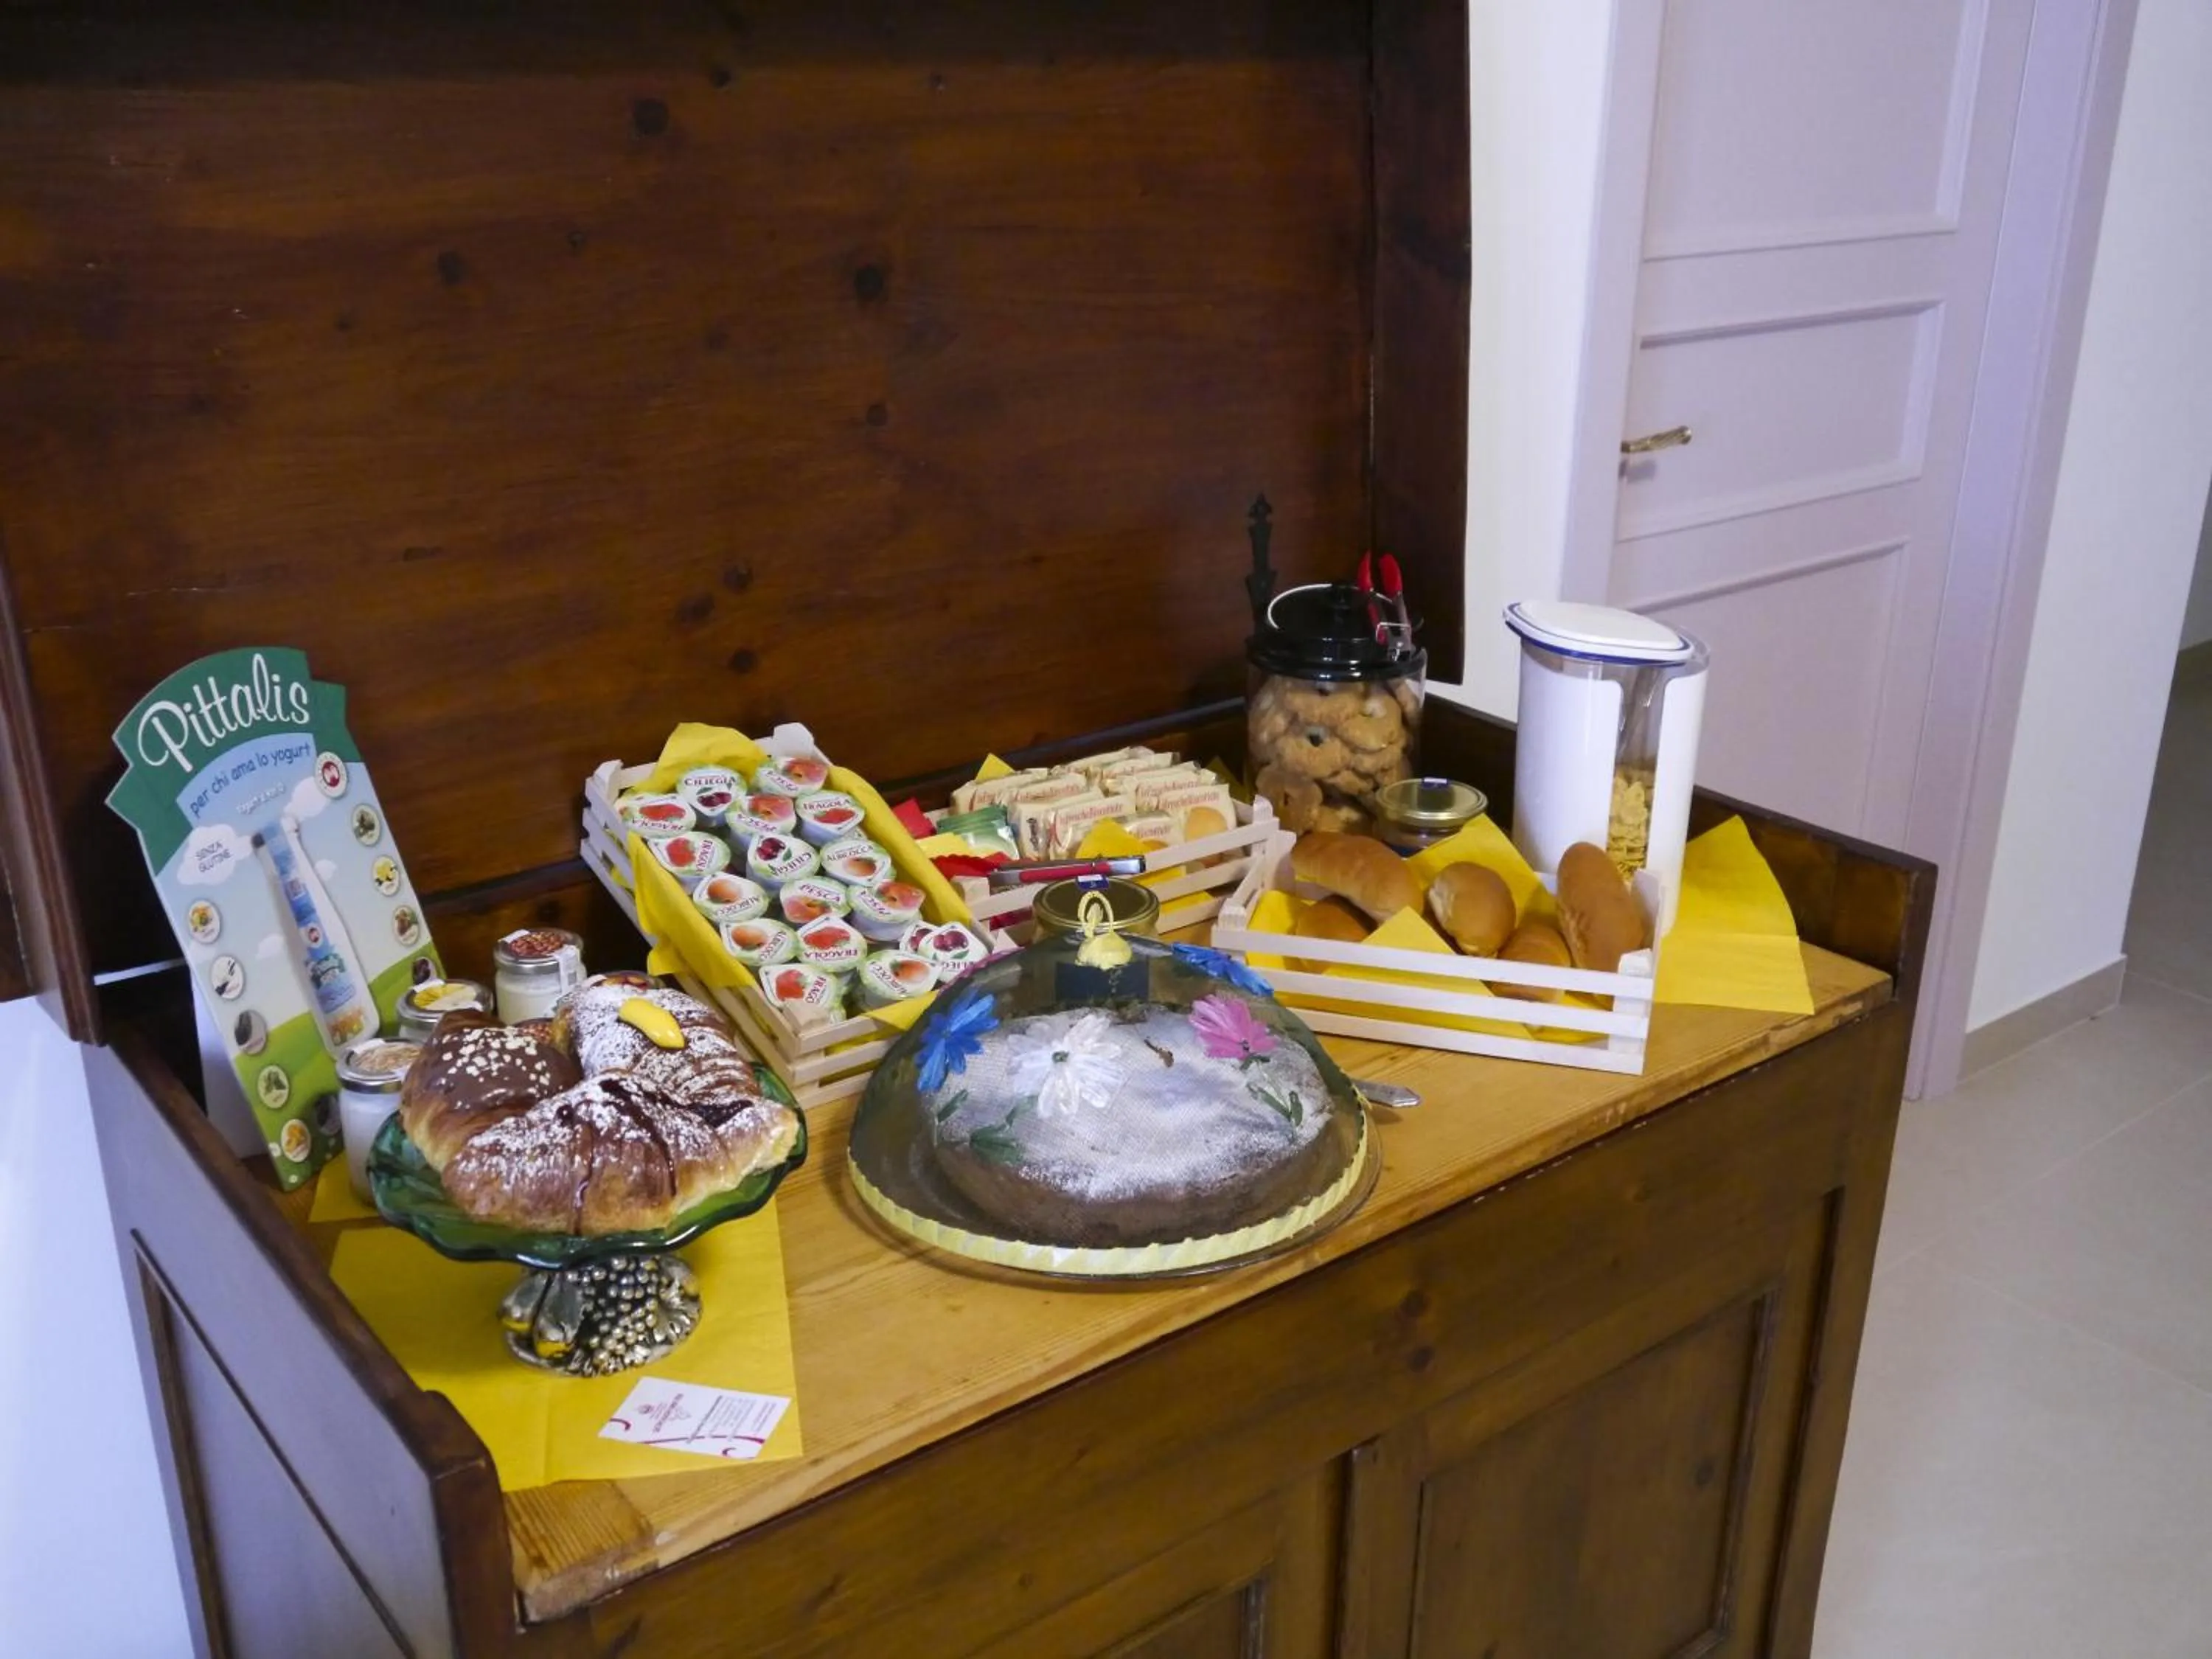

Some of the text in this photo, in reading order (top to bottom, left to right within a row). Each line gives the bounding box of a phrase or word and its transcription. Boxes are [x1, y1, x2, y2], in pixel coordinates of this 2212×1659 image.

[137, 653, 310, 773] Pittalis
[189, 789, 209, 818] per
[212, 770, 229, 794] chi
[232, 759, 257, 781] ama
[257, 753, 269, 768] lo
[271, 742, 310, 766] yogurt
